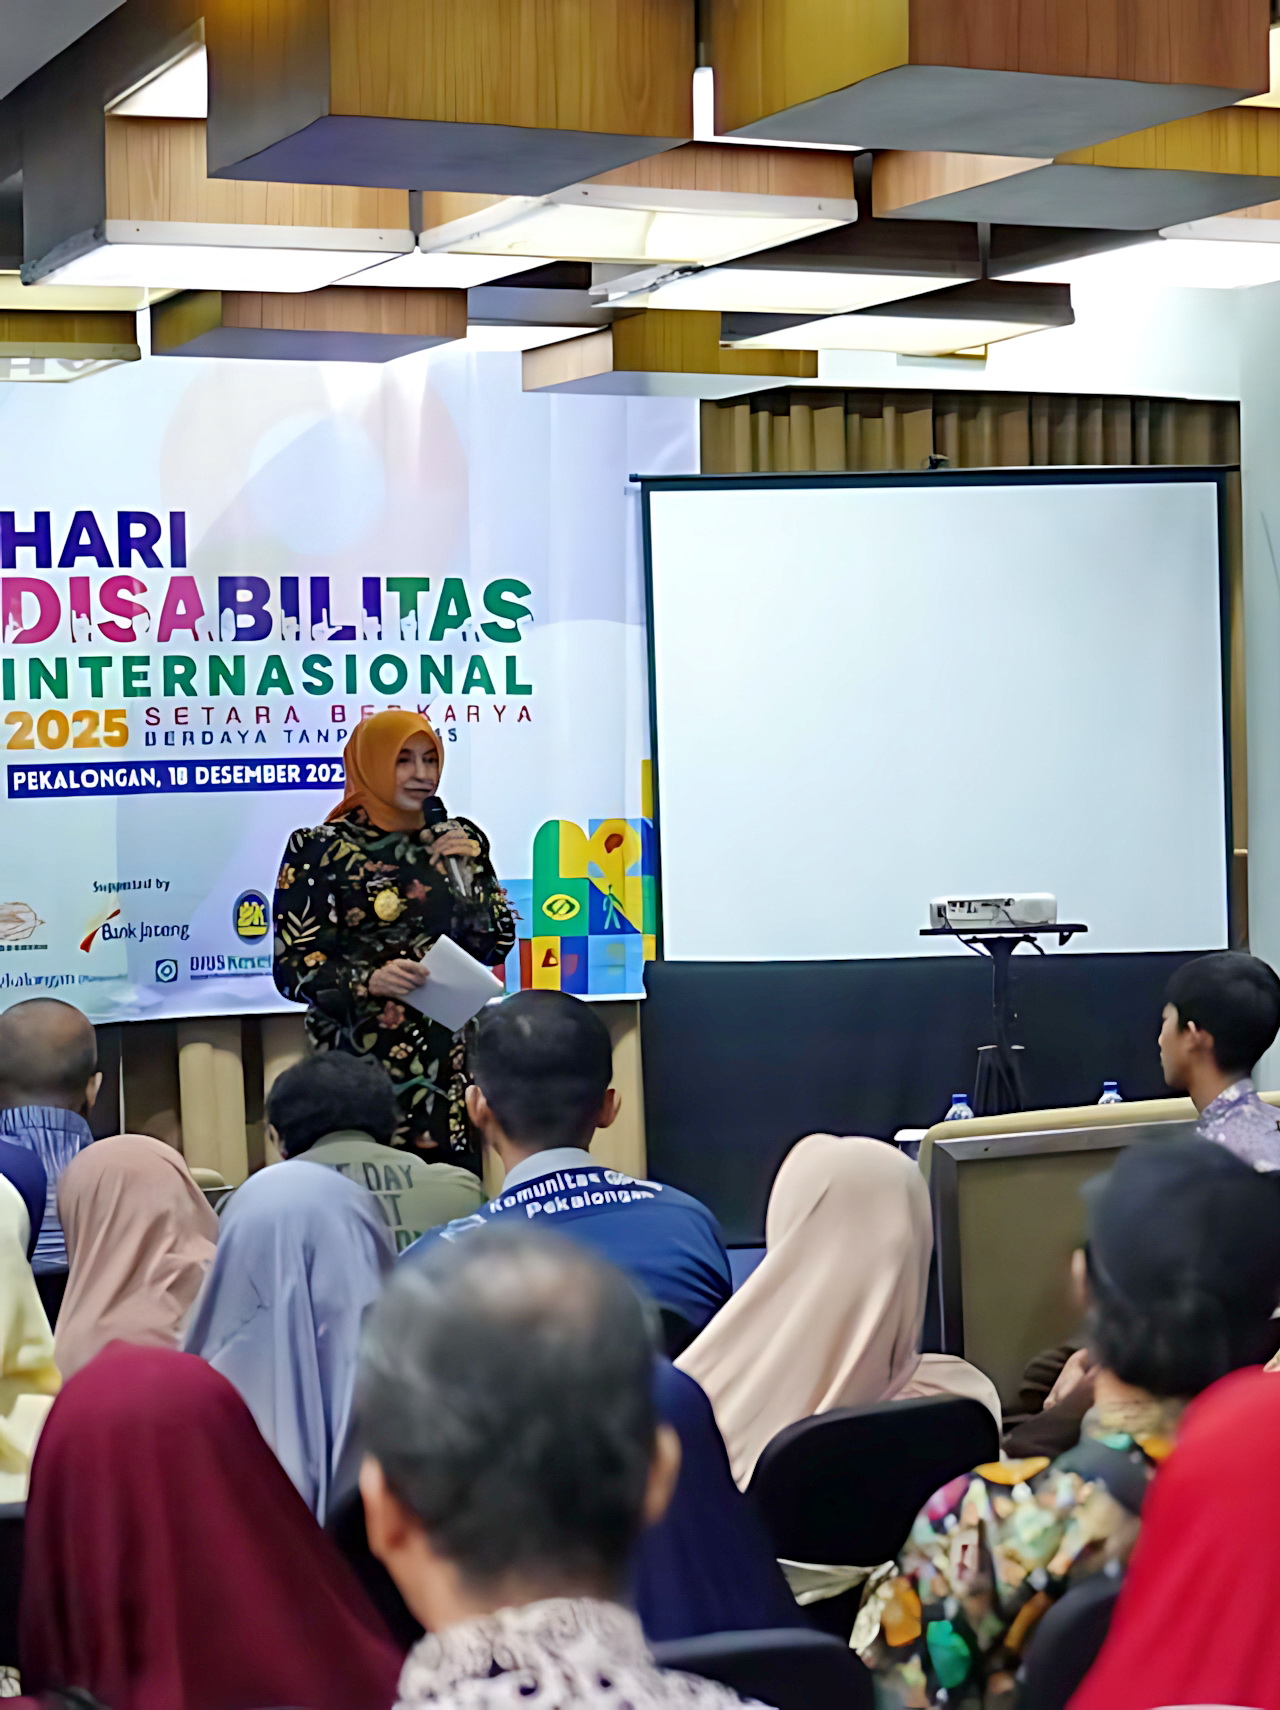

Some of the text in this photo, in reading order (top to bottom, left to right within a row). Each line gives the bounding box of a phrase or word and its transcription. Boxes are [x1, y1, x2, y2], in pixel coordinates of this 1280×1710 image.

[0, 511, 187, 568] HARI
[2, 575, 534, 645] DISABILITAS
[2, 654, 533, 700] INTERNASIONAL
[4, 709, 129, 750] 2025
[145, 704, 532, 726] SETARA BEKARYA
[284, 728, 348, 743] TANP
[13, 767, 161, 791] PEKALONGAN,
[195, 763, 301, 785] DESEMBER
[306, 763, 345, 783] 202
[362, 1162, 413, 1192] DAY
